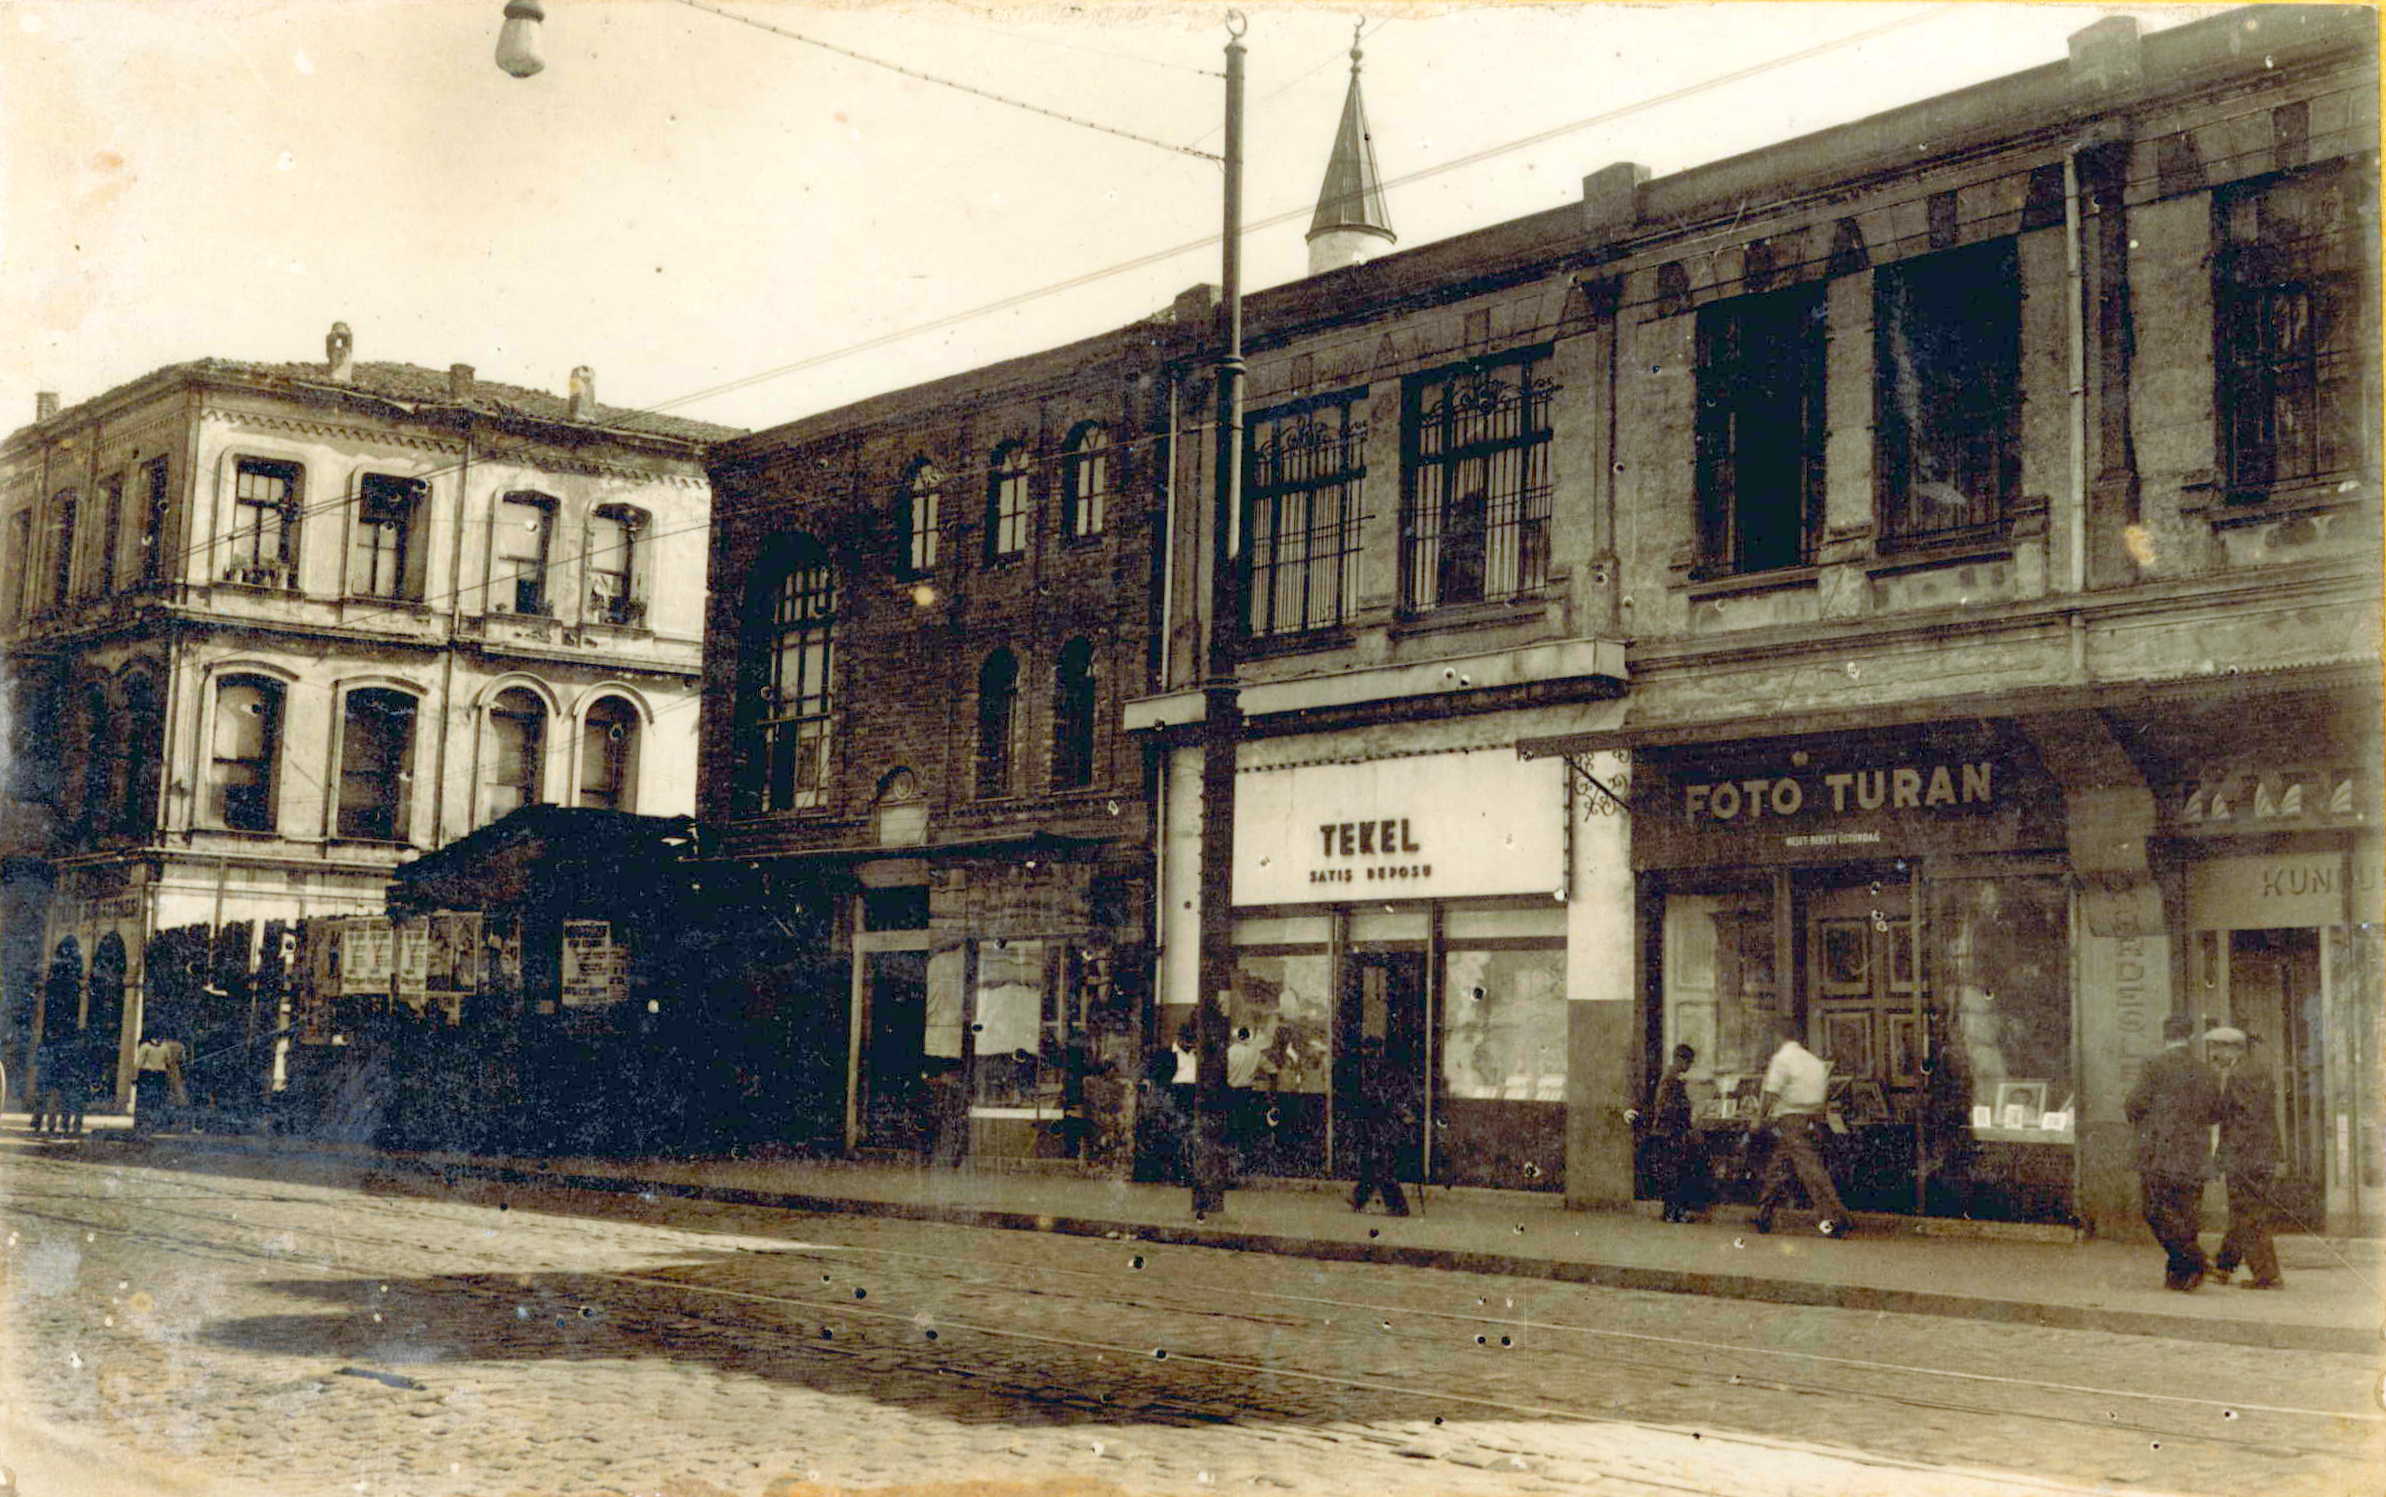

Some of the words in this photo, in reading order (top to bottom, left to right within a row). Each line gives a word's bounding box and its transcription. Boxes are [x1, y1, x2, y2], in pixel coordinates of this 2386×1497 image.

[1684, 777, 1803, 824] FOTO
[1825, 762, 1993, 812] TURAN
[1319, 818, 1421, 858] TEKEL
[1309, 869, 1353, 884] SATIŞ
[1366, 864, 1432, 881] DEPOSU
